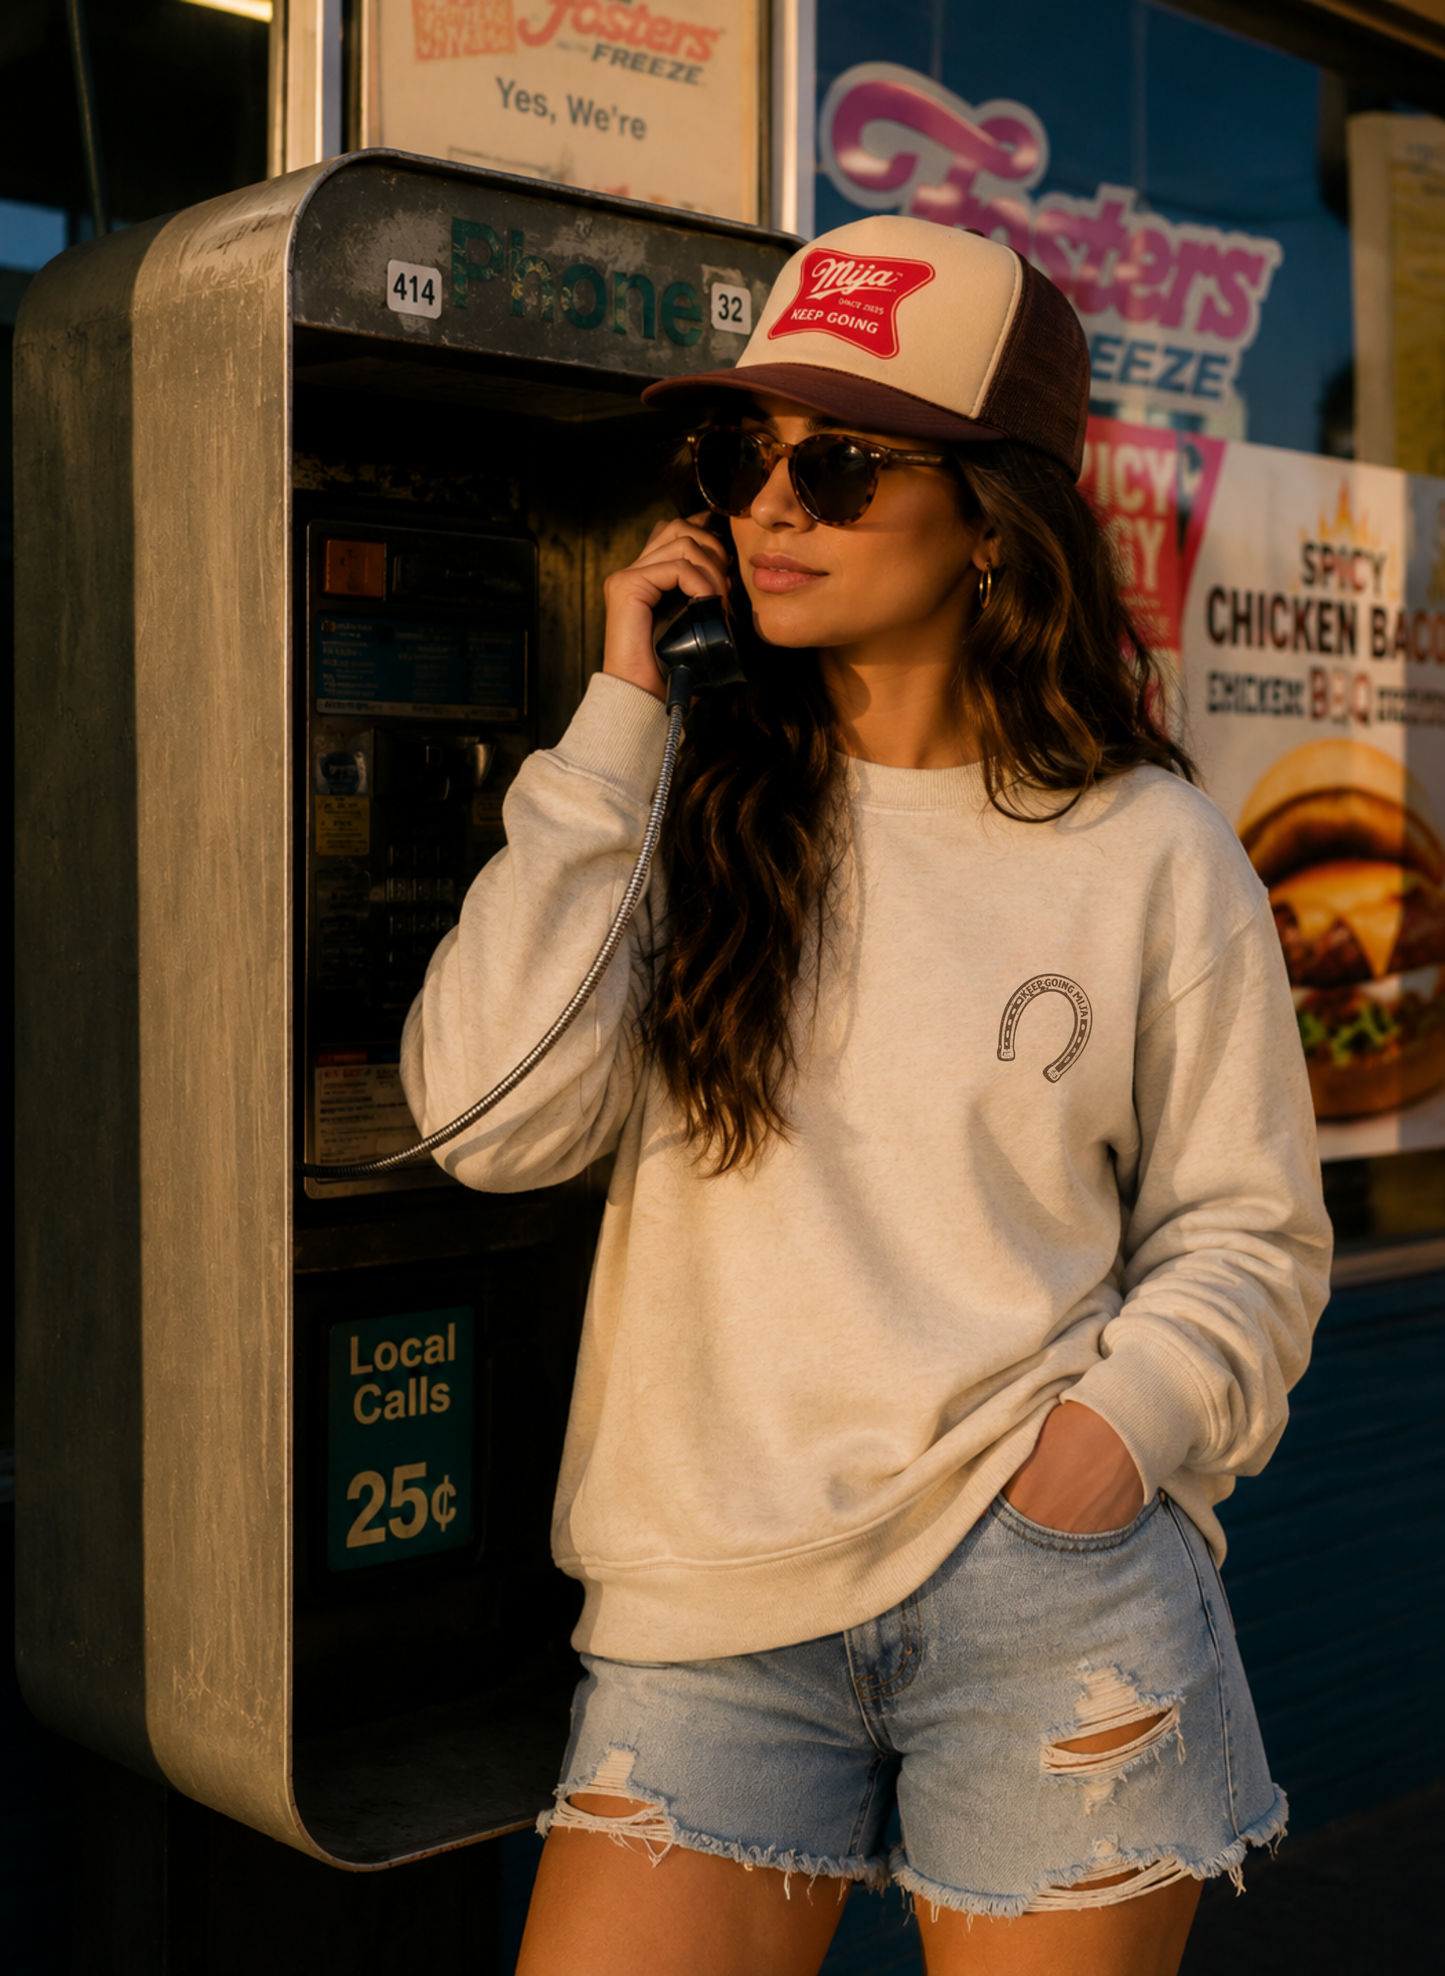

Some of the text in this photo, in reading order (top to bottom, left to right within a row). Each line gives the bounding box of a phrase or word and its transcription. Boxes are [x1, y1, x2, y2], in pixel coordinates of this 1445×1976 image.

[591, 42, 704, 86] FREEZE
[496, 76, 647, 140] Yes, We're
[393, 272, 436, 306] 414
[451, 217, 703, 347] Phone
[807, 258, 898, 298] Mija
[717, 293, 743, 323] 32
[791, 308, 879, 335] KEEP GOING
[1081, 441, 1177, 517] ICY
[1302, 542, 1387, 596] SPICY
[1207, 584, 1358, 658] CHICKEN
[1020, 978, 1089, 1018] KEEP GOING MIJA
[350, 1322, 456, 1376] Local
[353, 1376, 451, 1425] Calls
[346, 1461, 457, 1549] 25¢
